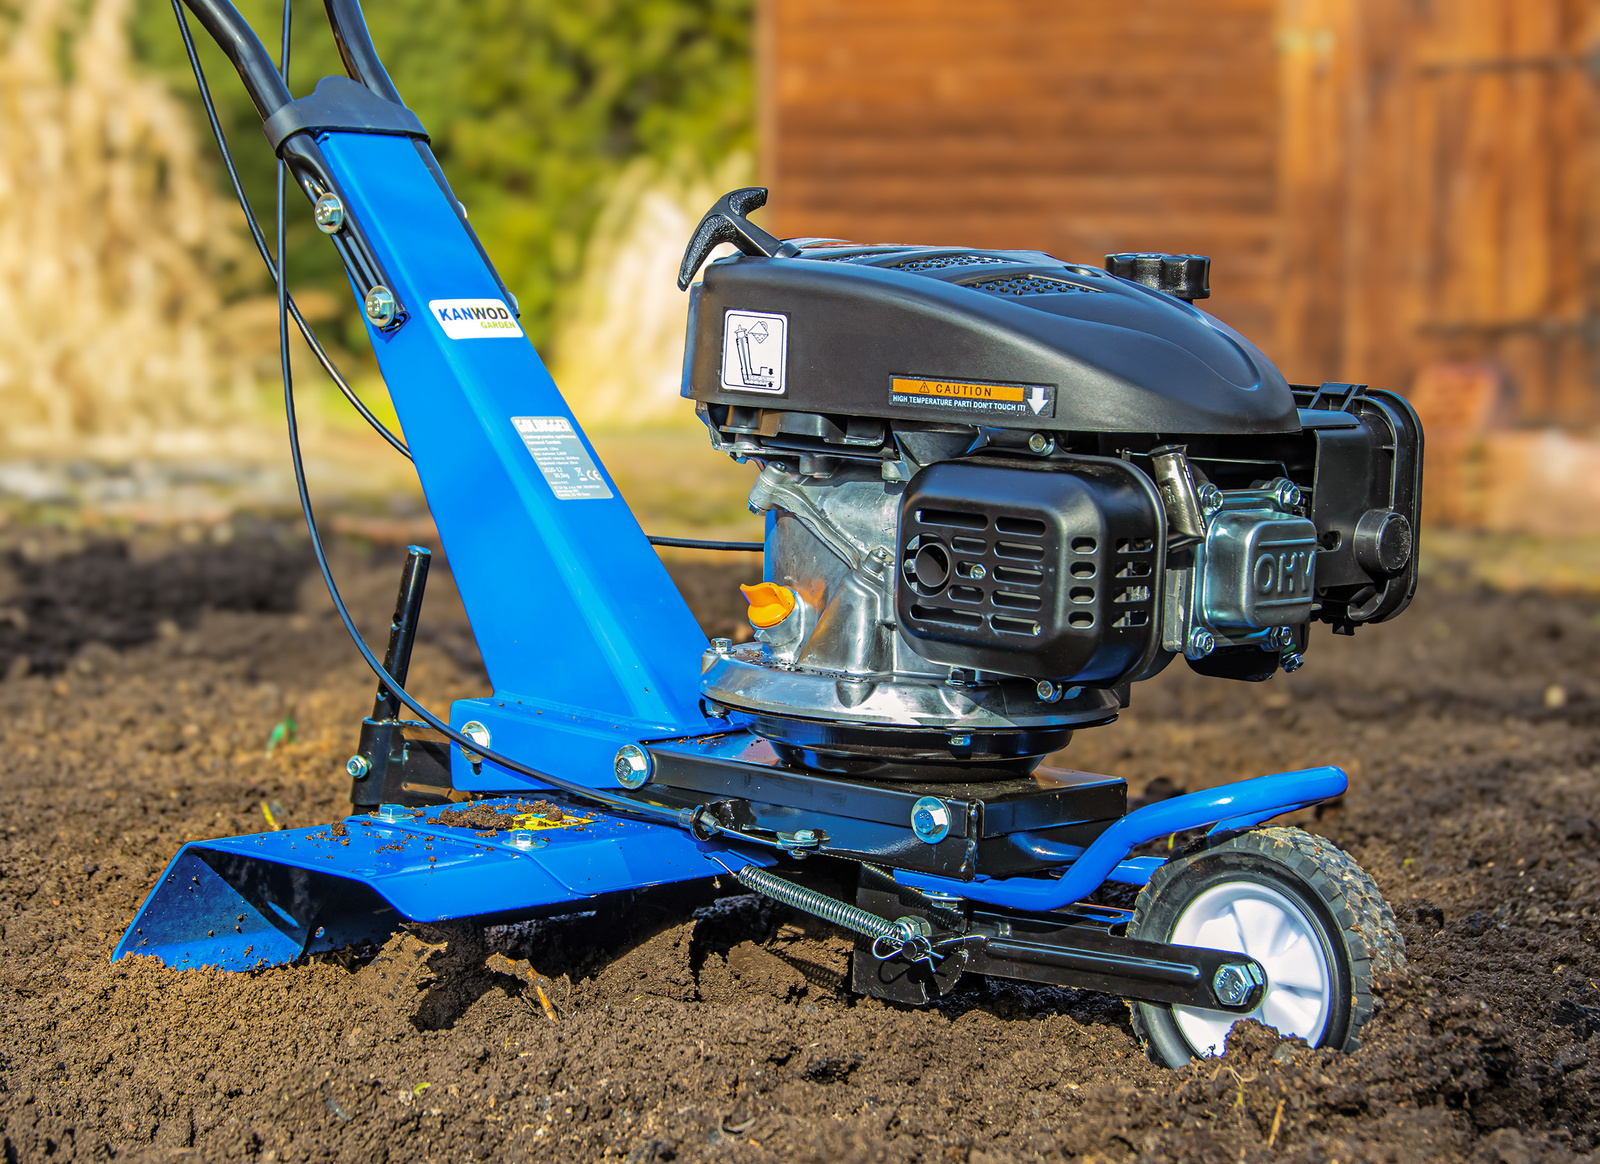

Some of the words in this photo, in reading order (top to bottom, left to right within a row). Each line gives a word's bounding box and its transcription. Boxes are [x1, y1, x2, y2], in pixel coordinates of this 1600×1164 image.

[438, 306, 509, 321] KANWOD
[480, 321, 516, 329] GARDEN
[935, 383, 992, 397] CAUTION
[892, 394, 908, 403] HIGH
[908, 396, 953, 407] TEMPERATURE
[993, 402, 1016, 411] TOUCH
[1253, 550, 1316, 596] OHV
